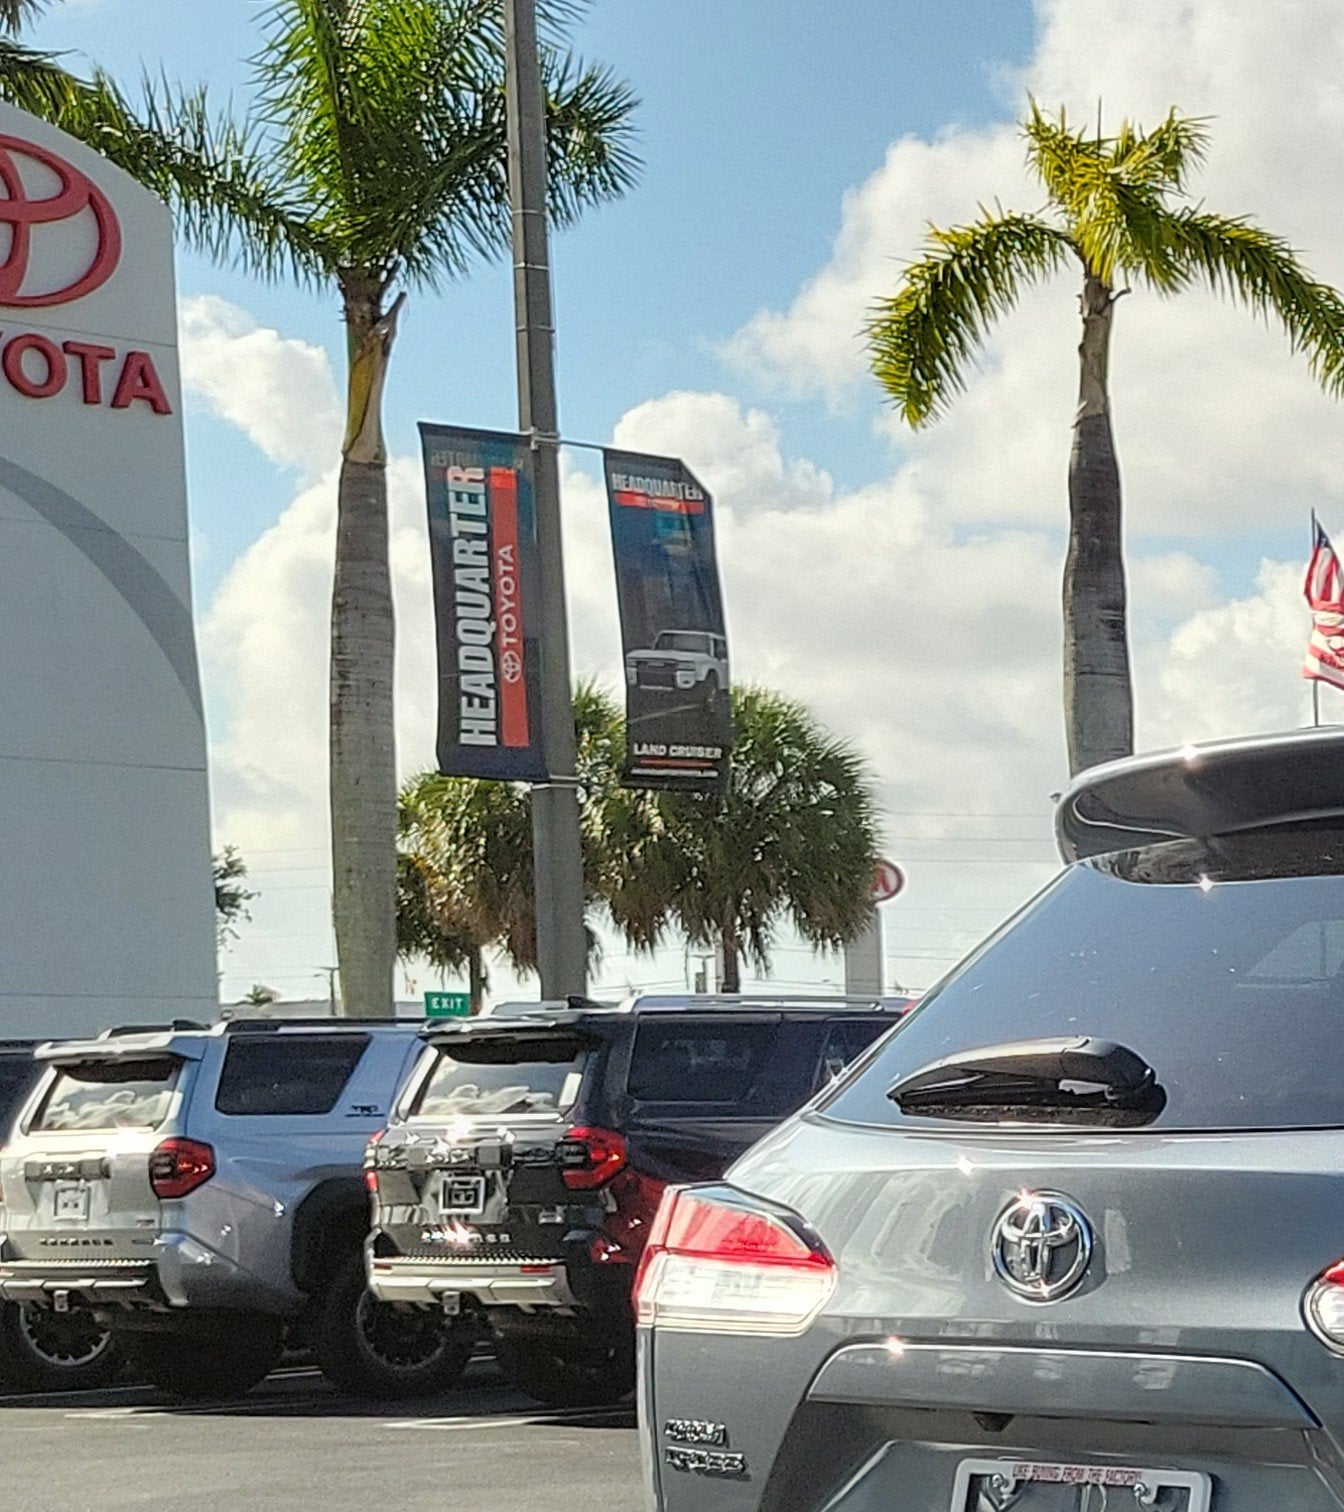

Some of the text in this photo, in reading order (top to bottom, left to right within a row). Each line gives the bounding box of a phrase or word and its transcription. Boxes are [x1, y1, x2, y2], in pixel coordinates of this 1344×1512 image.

[0, 331, 173, 415] OTA
[446, 465, 498, 747] HEADQUARTER
[498, 544, 519, 647] TOYOTA
[633, 742, 723, 759] LAND CRUISER
[430, 996, 463, 1010] EXIT
